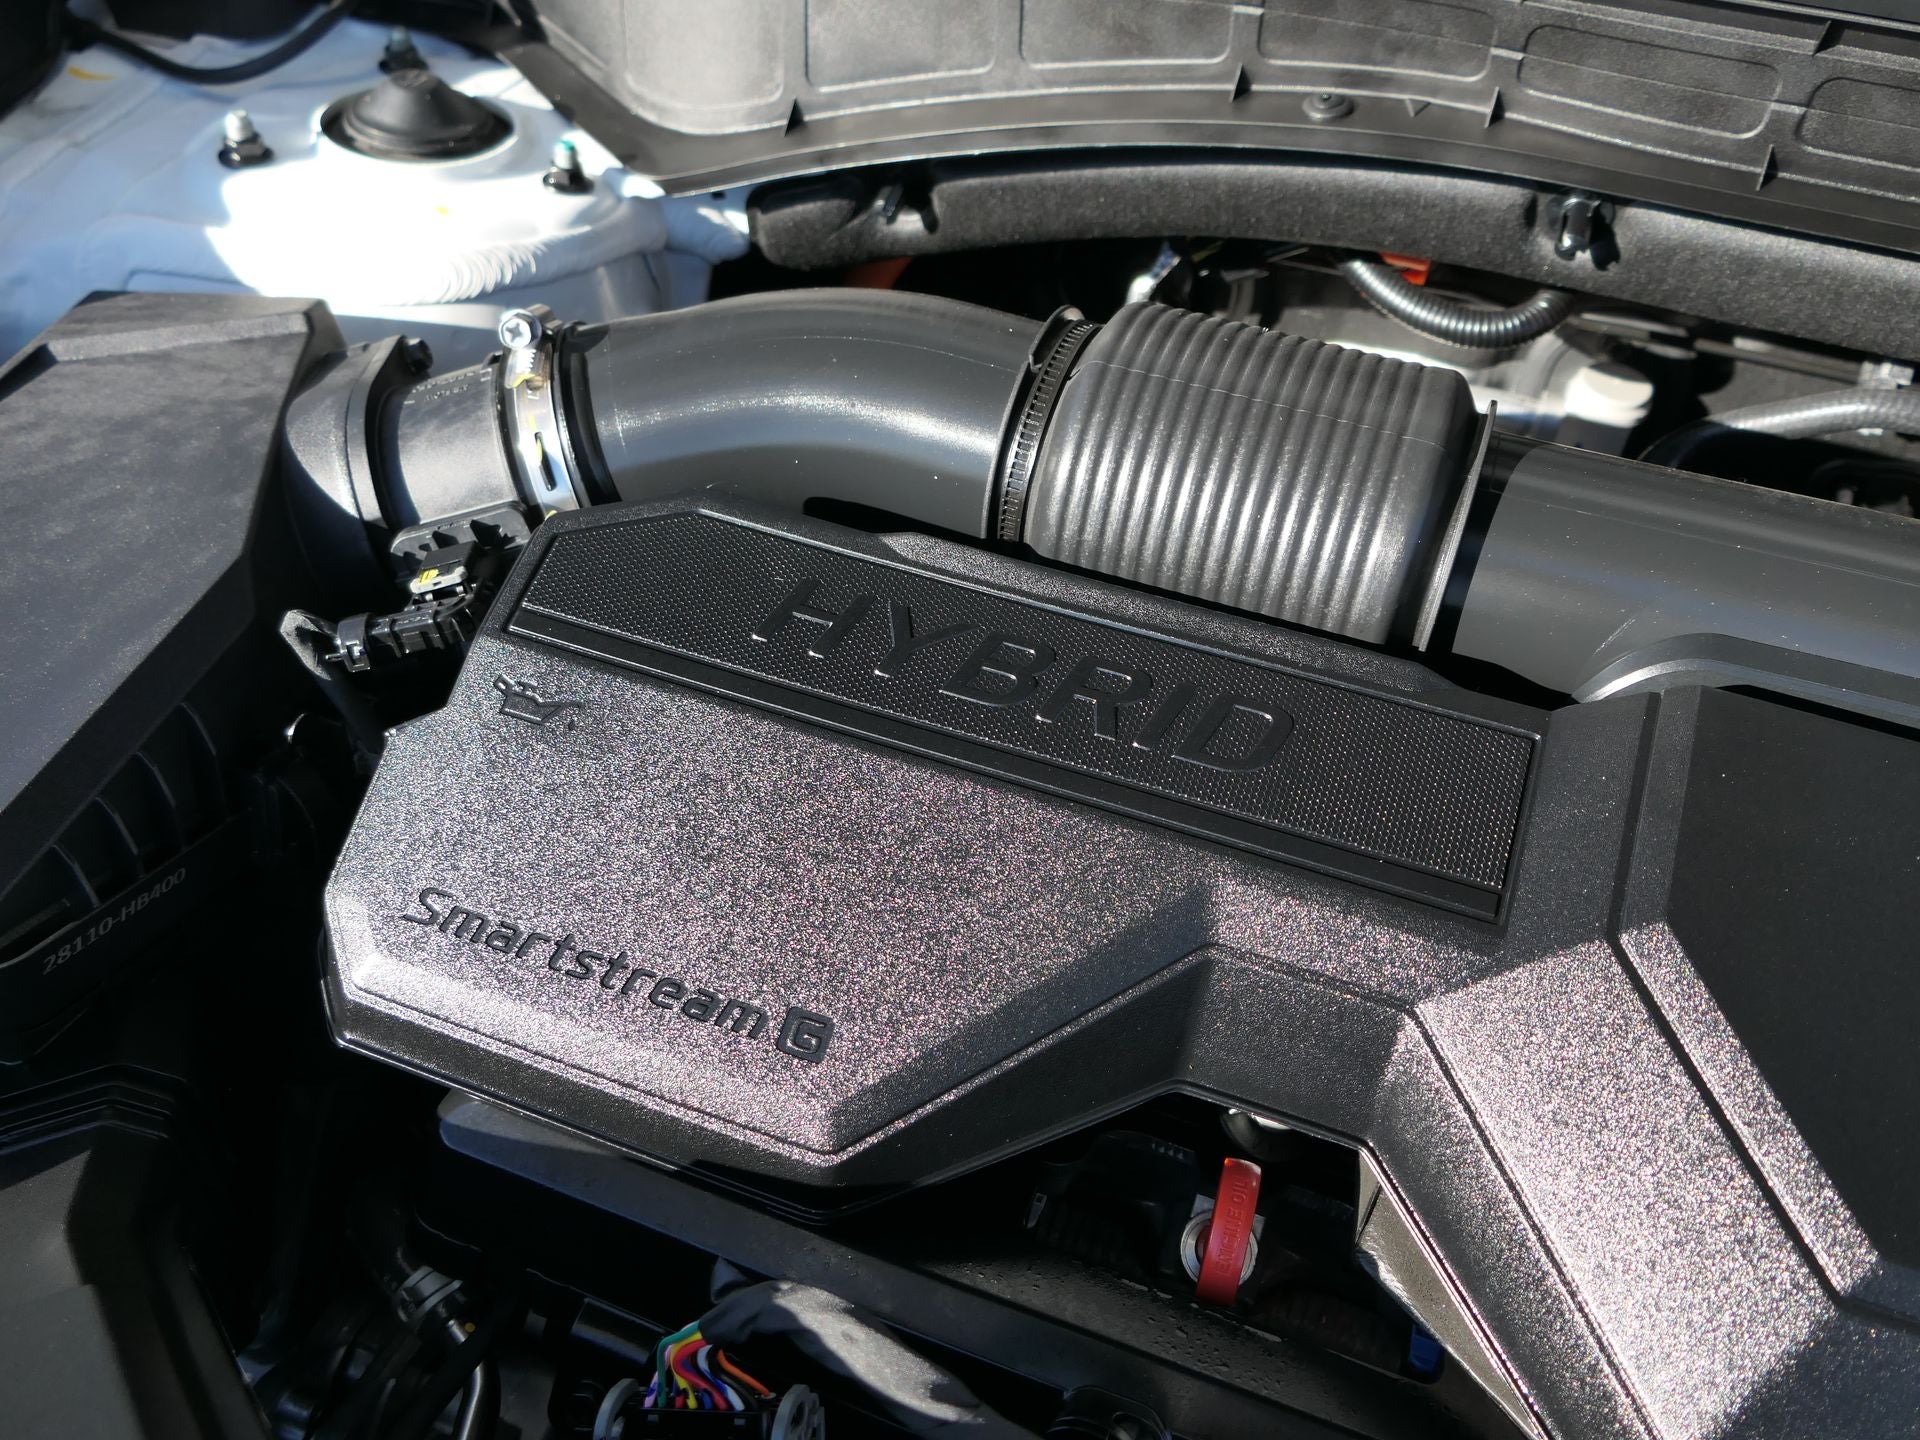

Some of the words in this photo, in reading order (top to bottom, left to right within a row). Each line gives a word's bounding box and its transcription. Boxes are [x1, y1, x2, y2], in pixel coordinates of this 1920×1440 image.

[752, 578, 1295, 773] HYBRID
[43, 867, 186, 976] 28110-HB400
[403, 887, 769, 1038] Smartstream
[779, 1007, 834, 1062] G
[1215, 1208, 1242, 1276] ENGINE
[1232, 1175, 1249, 1203] OIL
